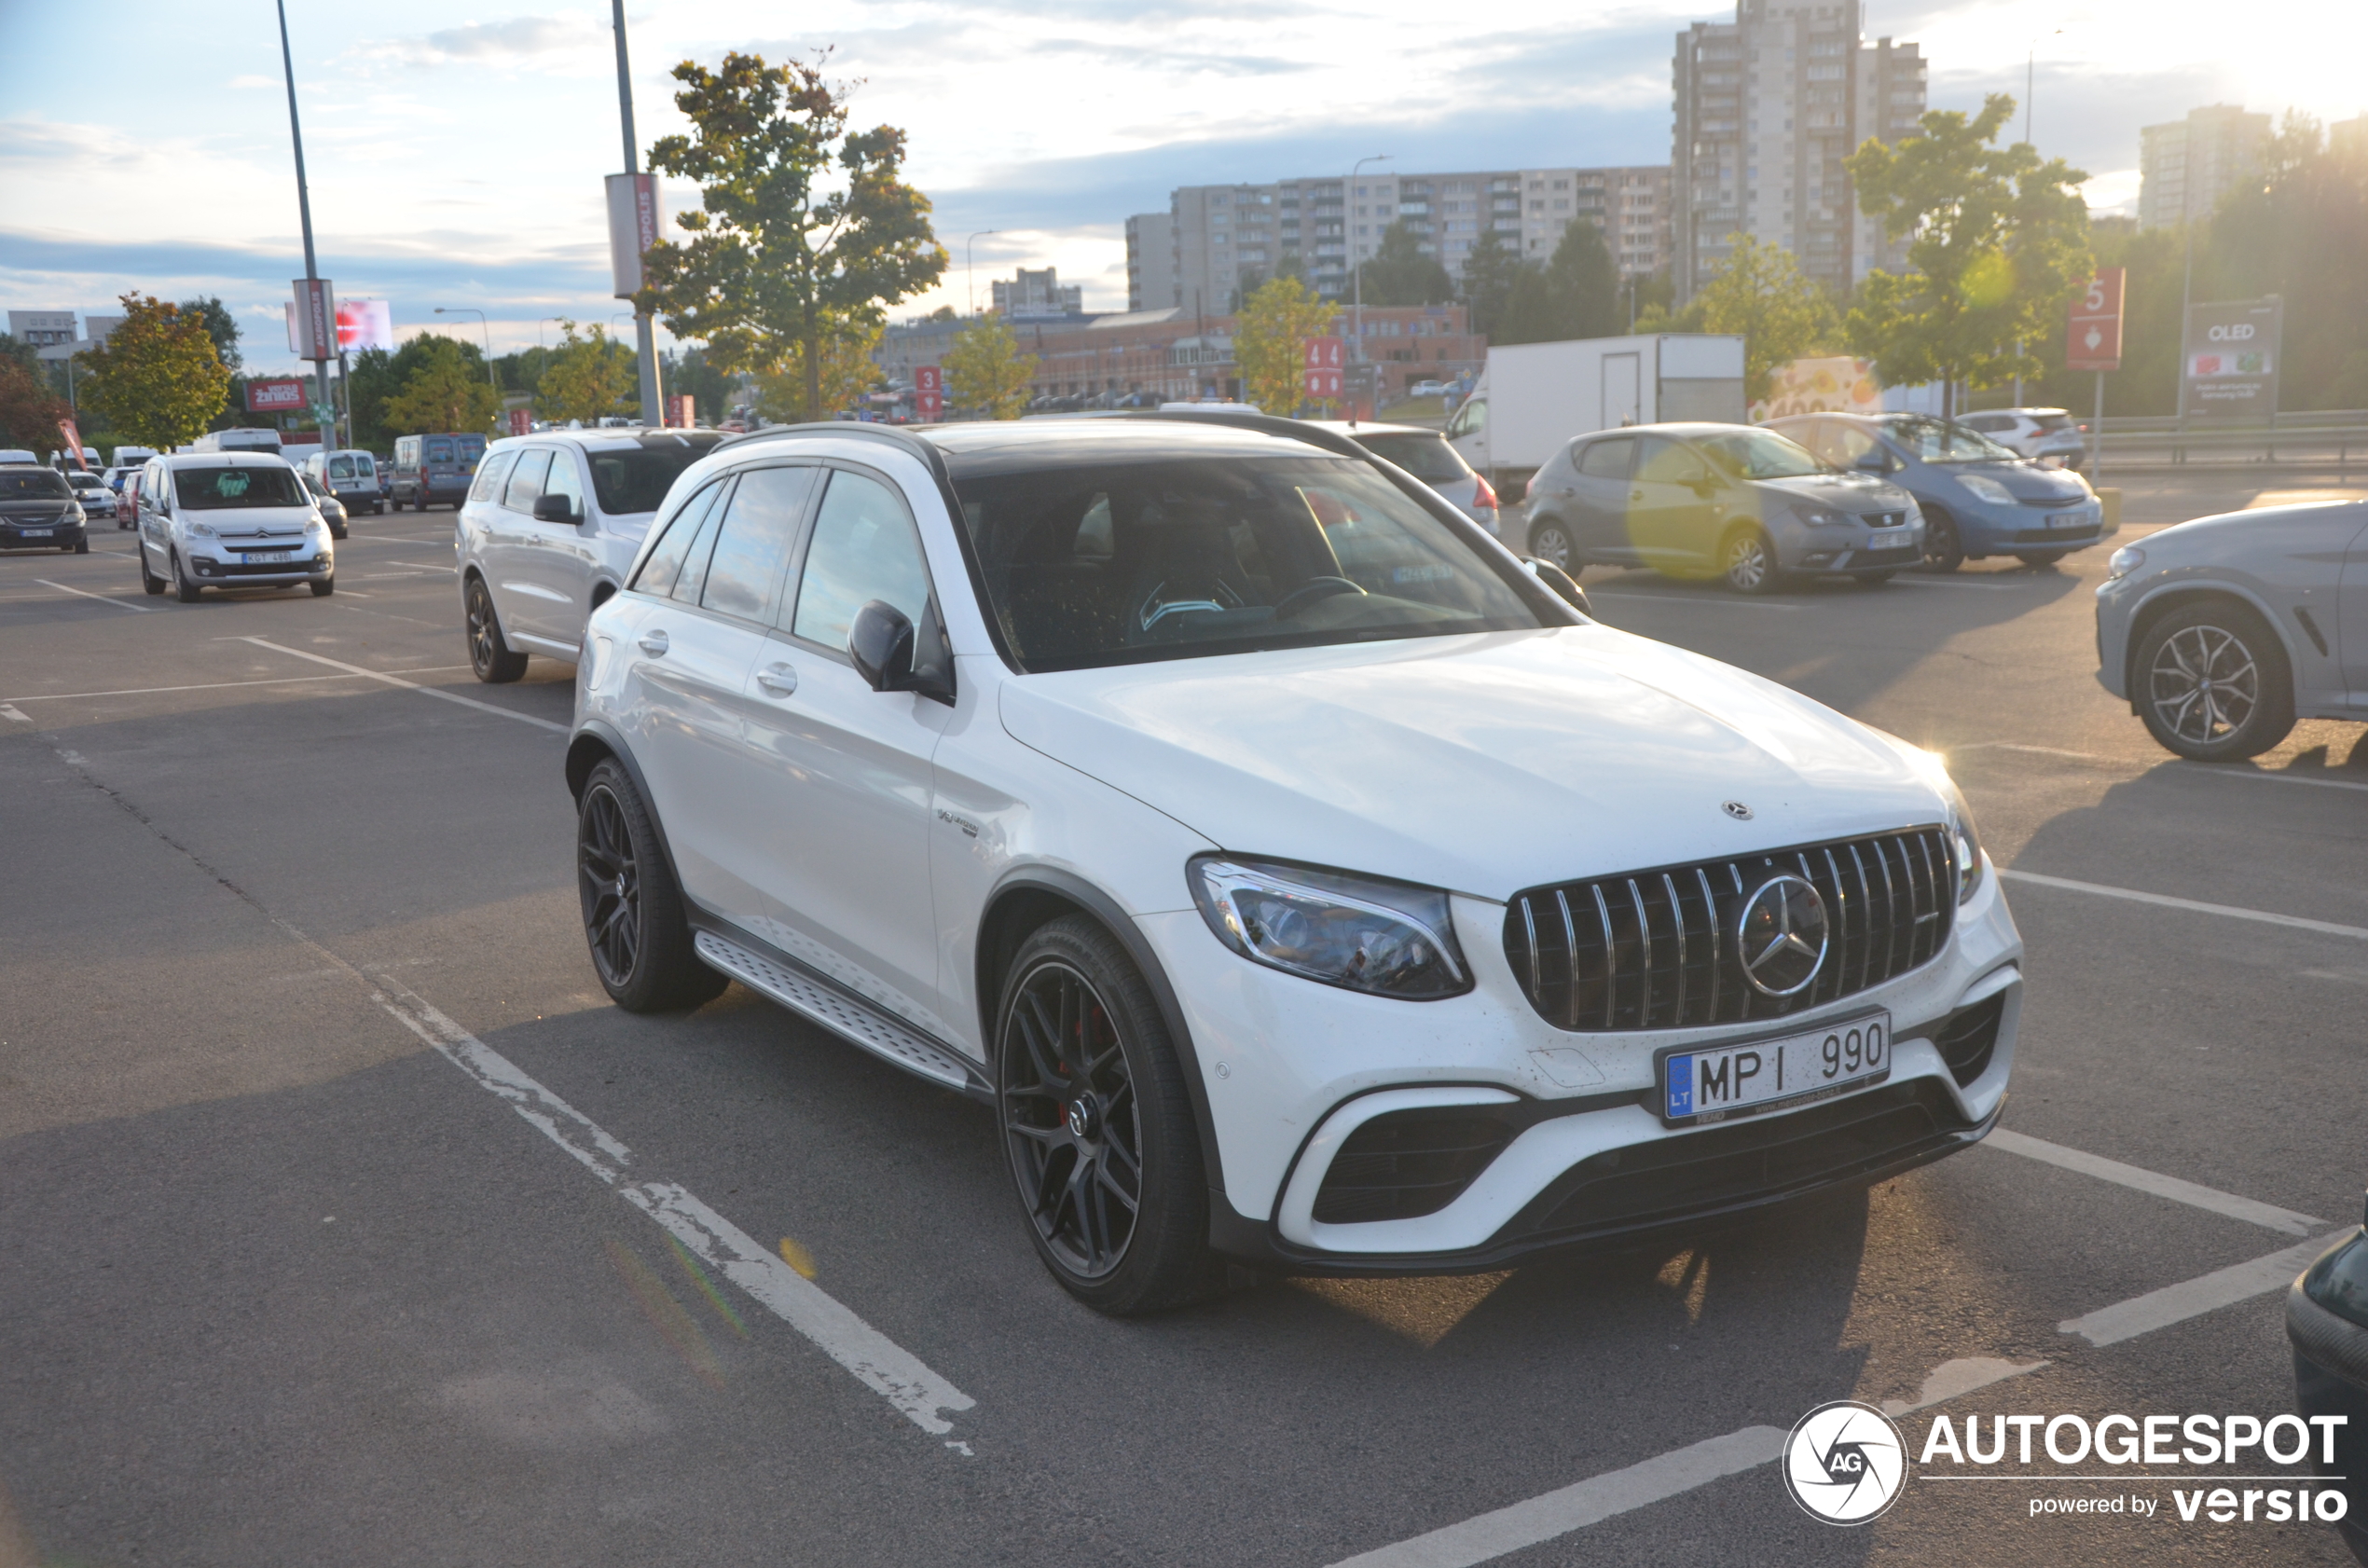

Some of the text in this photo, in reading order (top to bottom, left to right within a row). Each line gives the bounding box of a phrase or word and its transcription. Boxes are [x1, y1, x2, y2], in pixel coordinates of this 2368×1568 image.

[2086, 279, 2105, 311] 5
[310, 291, 325, 347] AKROPOLIS
[2208, 323, 2255, 342] OLED
[1311, 344, 1320, 365] 4
[1330, 344, 1339, 365] 4
[923, 371, 934, 389] 3
[673, 400, 681, 414] 2
[248, 554, 267, 562] KGT
[1700, 1022, 1882, 1106] MPI 990
[1671, 1091, 1689, 1107] LT
[1696, 1085, 1842, 1125] VEHO www.mercedes-benz.lt
